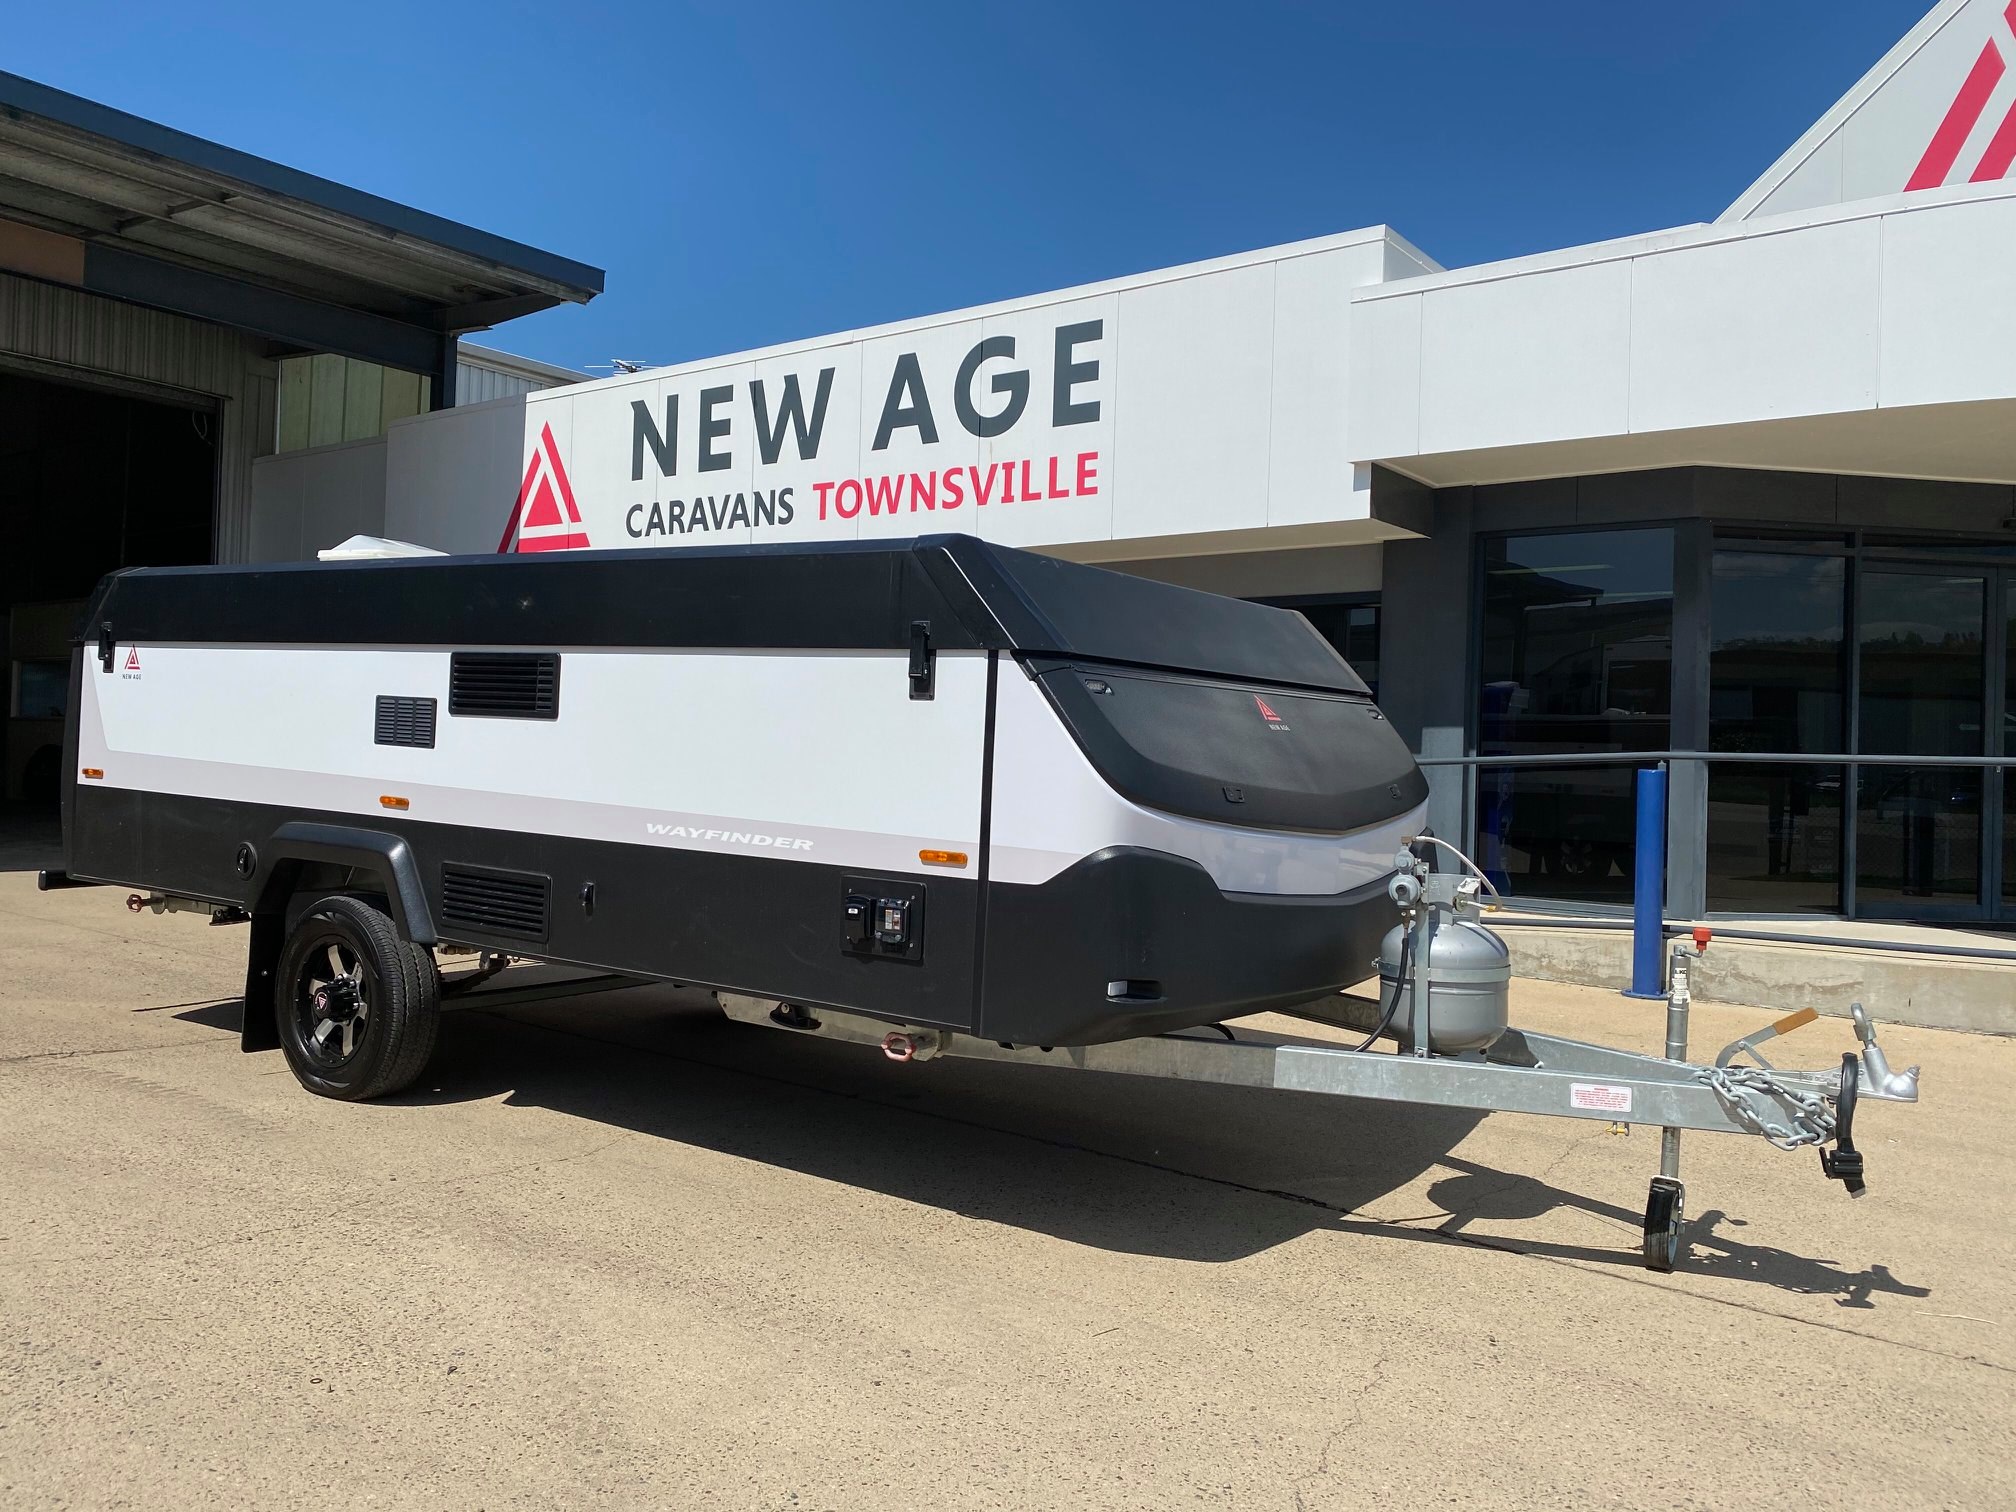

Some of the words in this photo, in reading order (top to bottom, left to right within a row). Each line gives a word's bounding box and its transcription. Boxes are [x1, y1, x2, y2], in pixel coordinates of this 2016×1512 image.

[630, 366, 836, 482] NEW
[871, 318, 1104, 451] AGE
[625, 487, 794, 539] CARAVANS
[812, 451, 1099, 521] TOWNSVILLE
[646, 823, 814, 851] WAYFINDER
